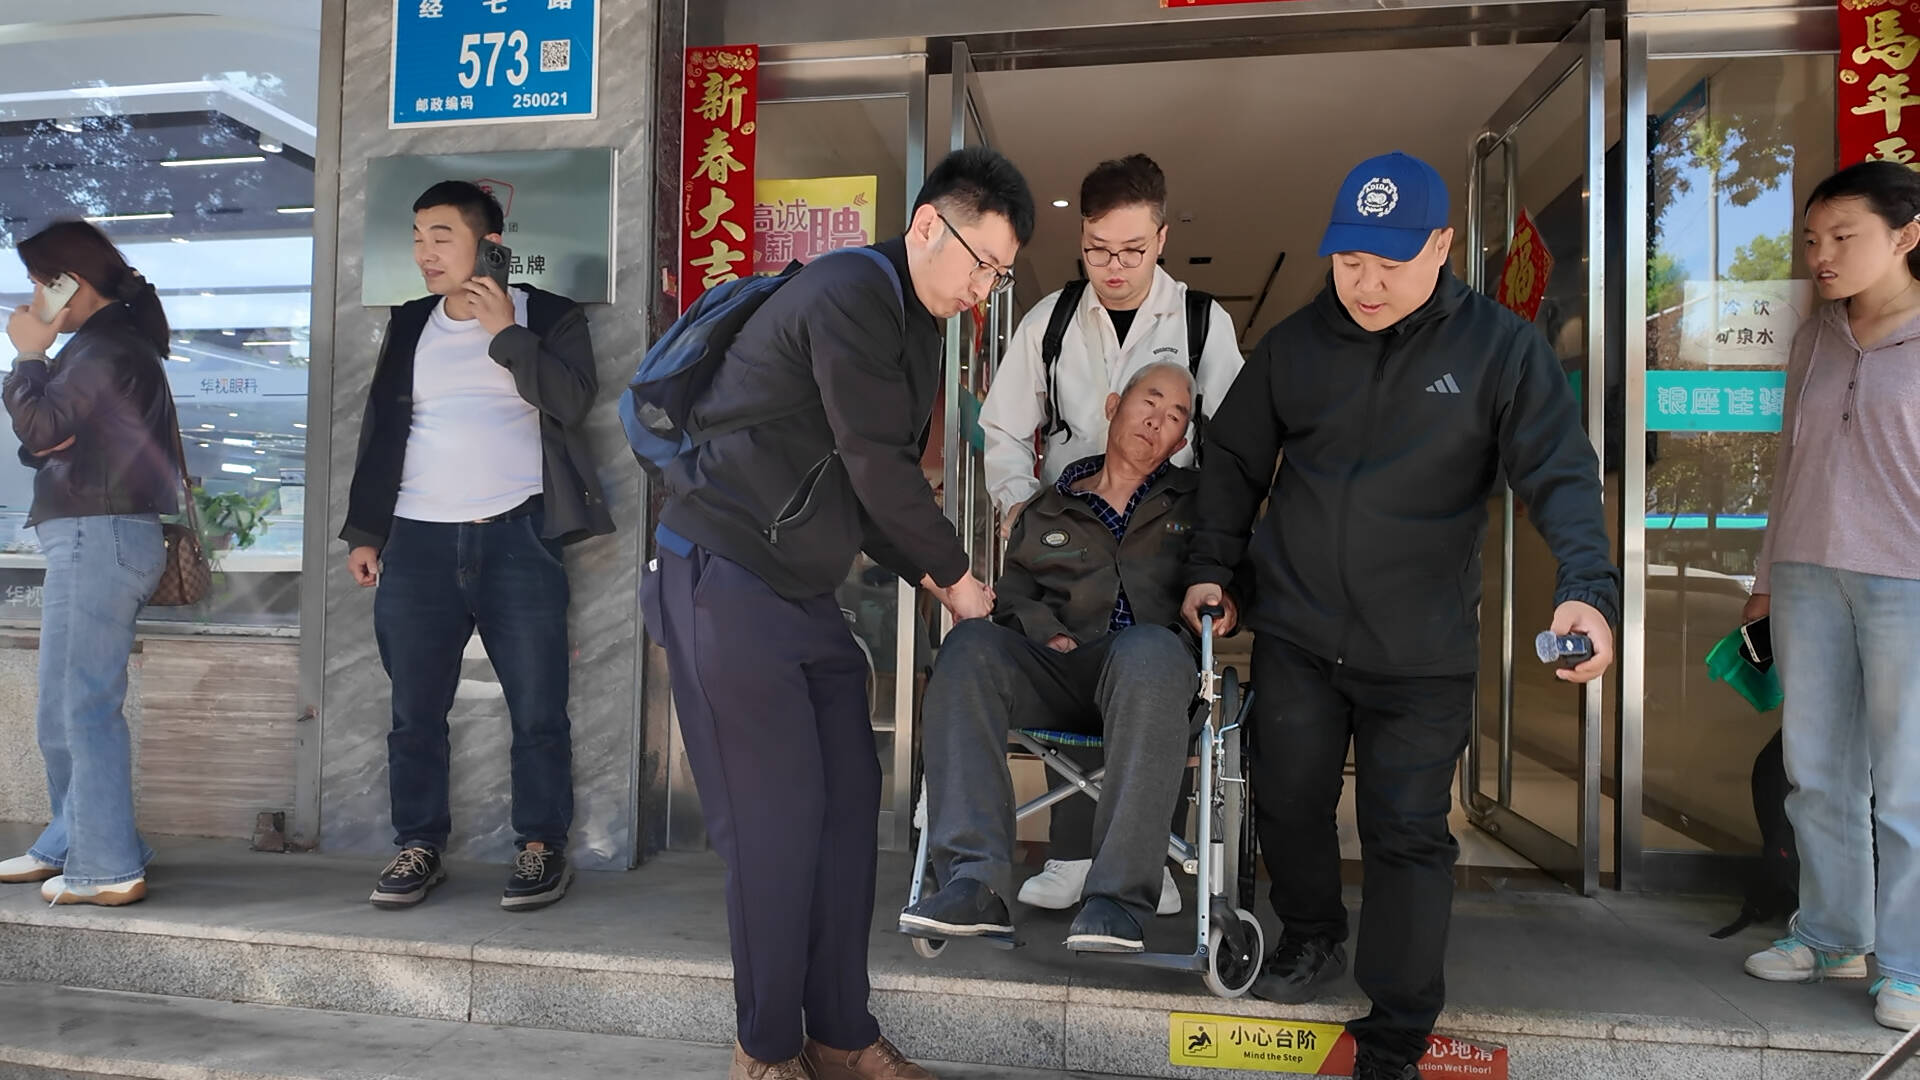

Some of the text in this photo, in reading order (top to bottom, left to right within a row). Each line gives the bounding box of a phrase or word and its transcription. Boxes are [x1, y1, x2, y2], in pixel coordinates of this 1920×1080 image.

[458, 30, 529, 89] 573
[415, 95, 474, 112] 邮政编码
[512, 92, 568, 108] 250021
[689, 72, 750, 290] 新春大吉
[200, 378, 258, 394] 华视眼科
[1230, 1025, 1317, 1050] 小心台阶
[1243, 1051, 1303, 1063] Mind the Step
